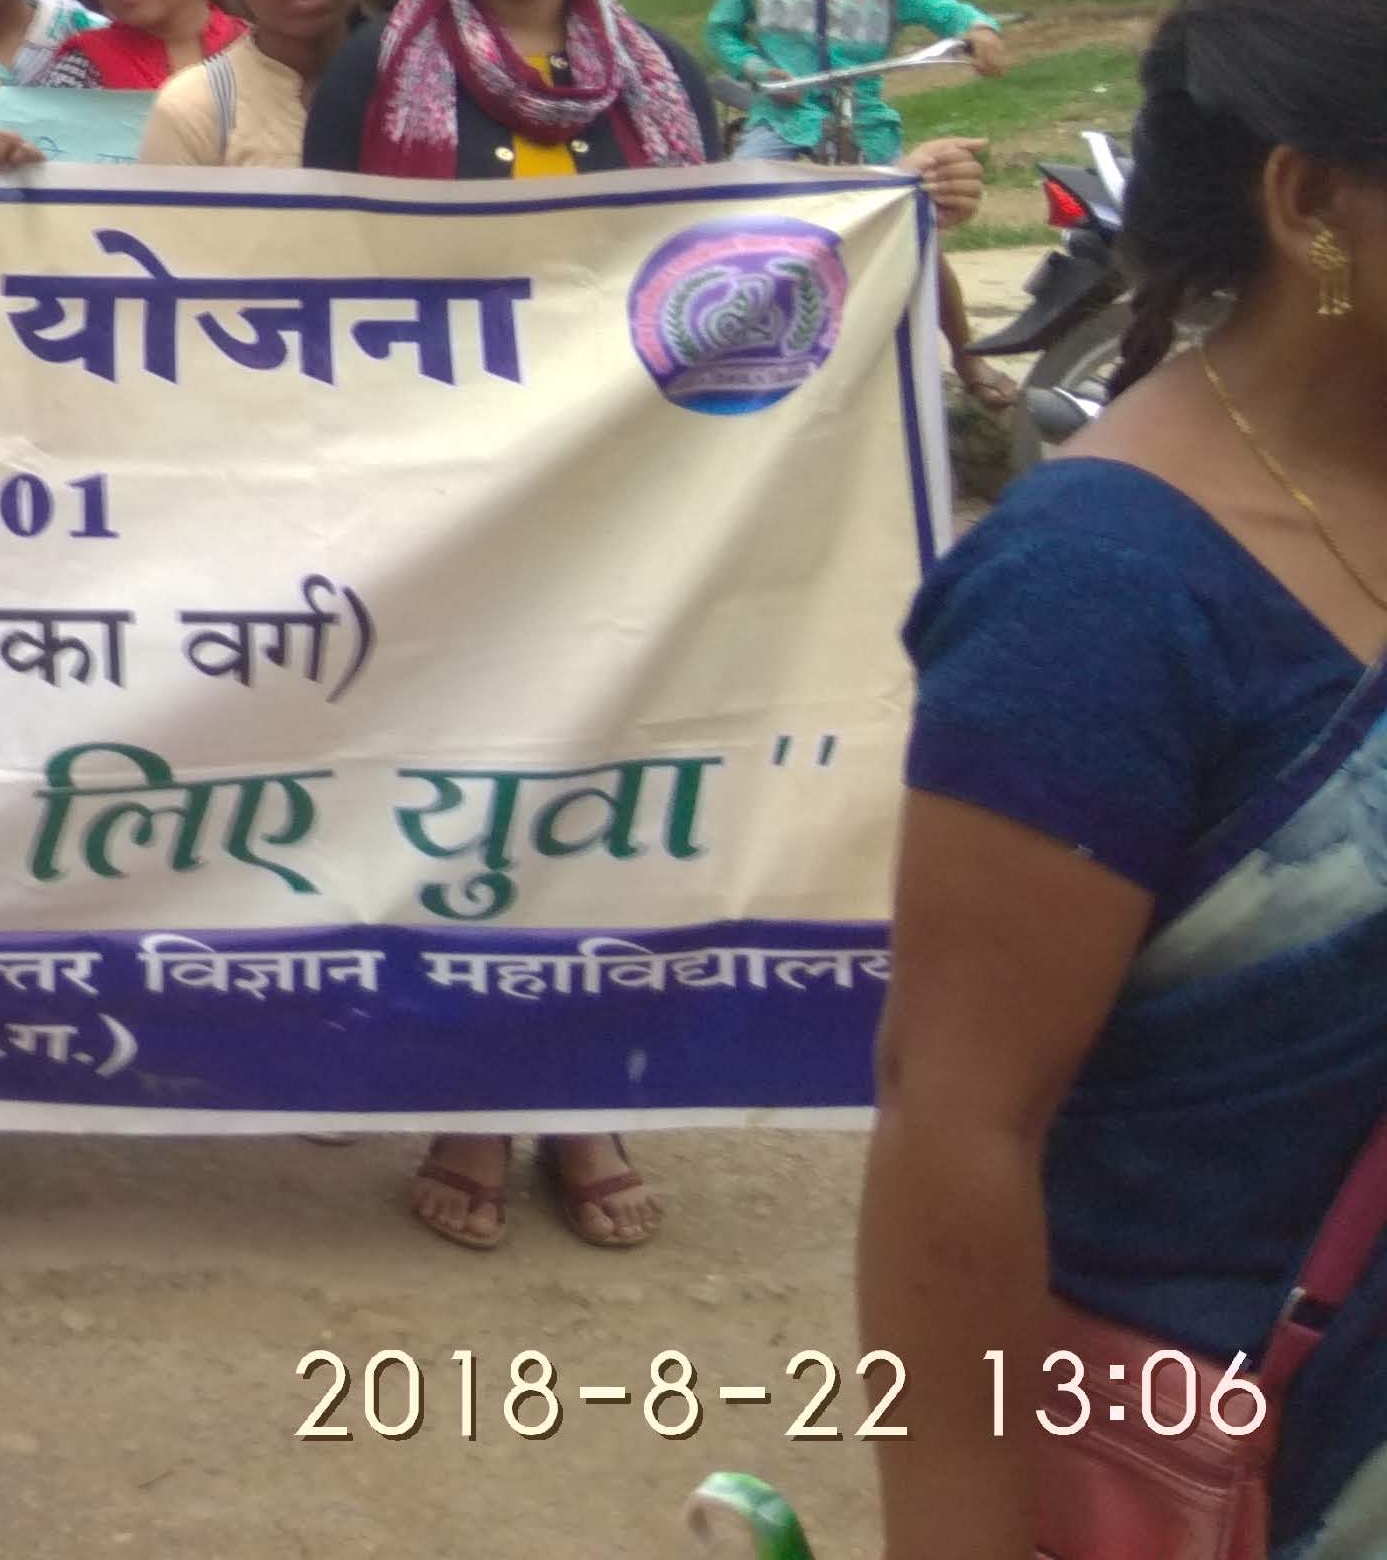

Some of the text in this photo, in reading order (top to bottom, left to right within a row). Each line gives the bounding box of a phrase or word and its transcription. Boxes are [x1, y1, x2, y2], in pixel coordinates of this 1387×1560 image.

[2, 229, 529, 386] योजना
[179, 574, 376, 703] वर्ग)
[26, 742, 335, 895] लिए
[137, 932, 385, 1002] विज्ञान
